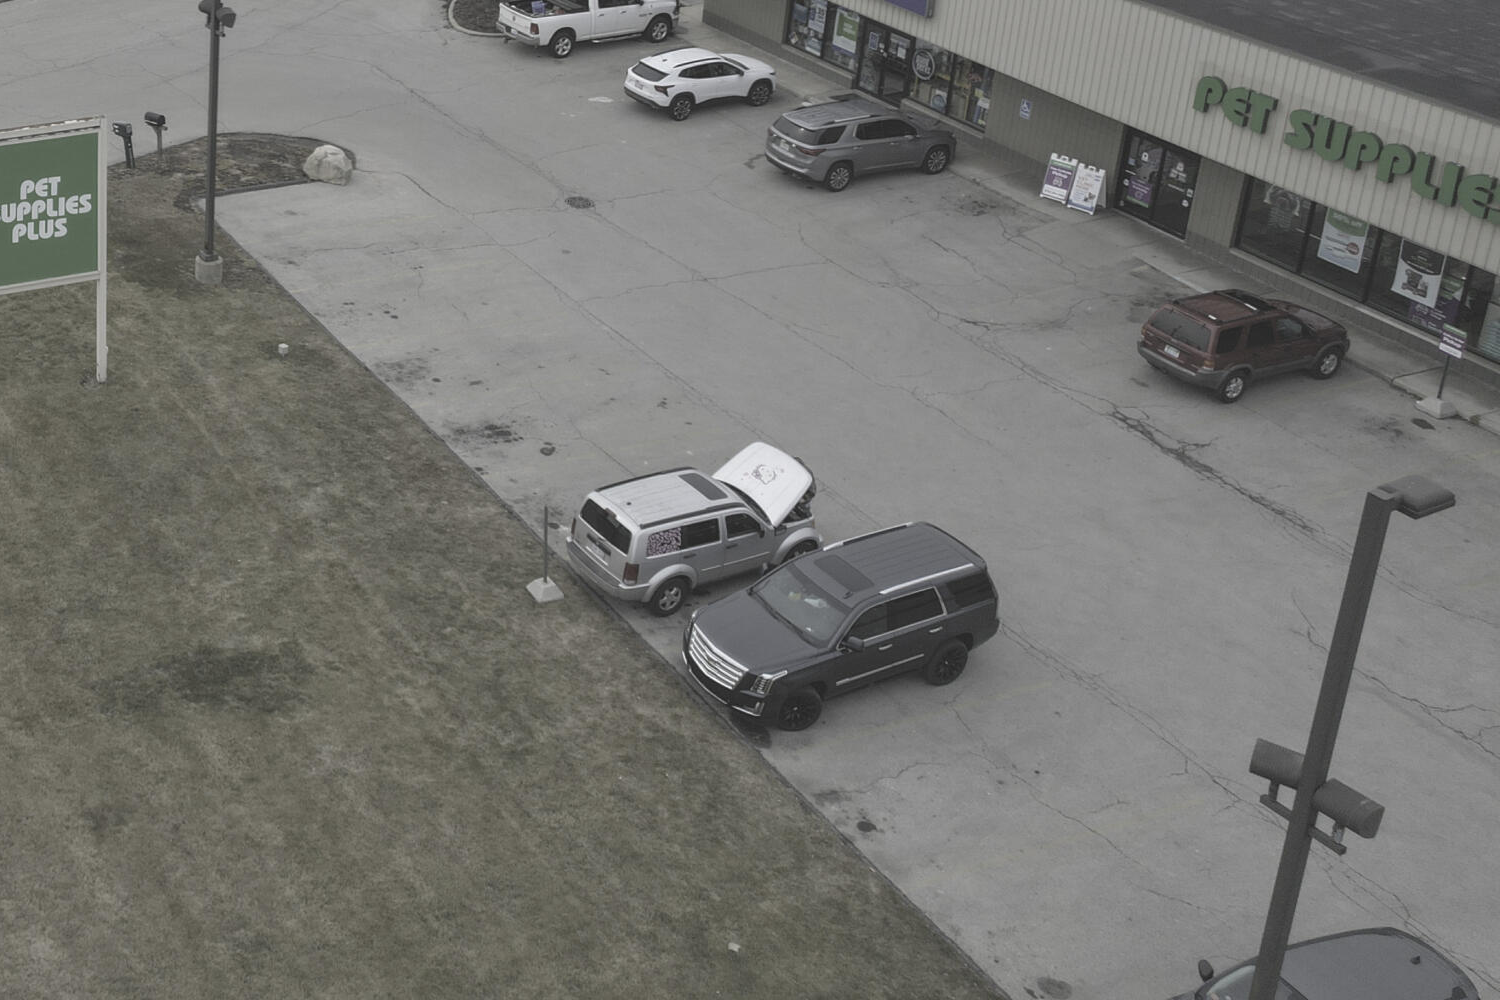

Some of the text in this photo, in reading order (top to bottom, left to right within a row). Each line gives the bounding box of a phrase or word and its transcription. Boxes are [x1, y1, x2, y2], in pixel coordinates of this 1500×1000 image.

[1192, 75, 1278, 134] PET
[19, 176, 62, 200] PET
[11, 217, 68, 244] PLUS
